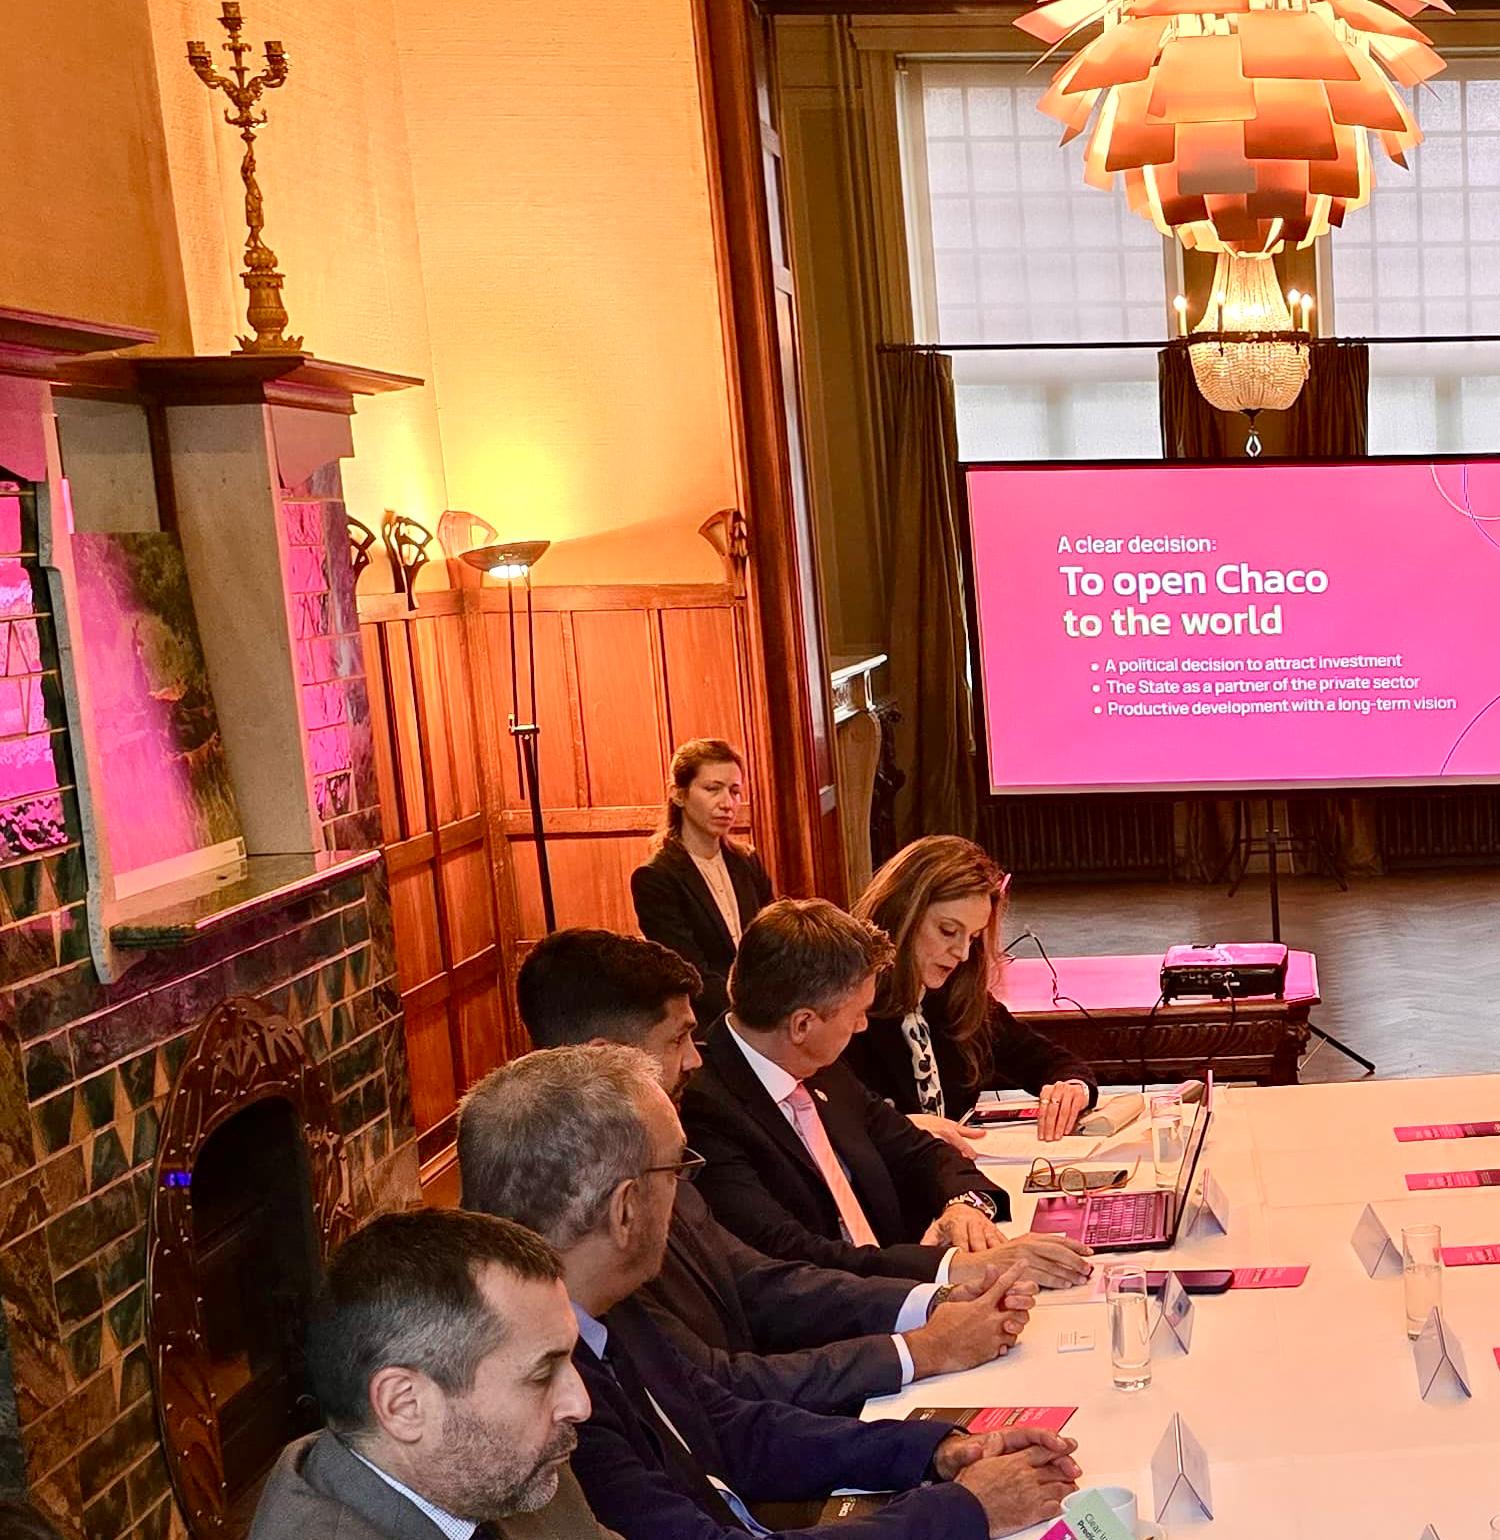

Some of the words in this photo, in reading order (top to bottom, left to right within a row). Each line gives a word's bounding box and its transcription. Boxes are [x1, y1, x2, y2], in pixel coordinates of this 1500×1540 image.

[1058, 536, 1072, 553] A
[1075, 535, 1124, 553] clear
[1127, 534, 1217, 553] decision:
[1059, 566, 1105, 597] To
[1113, 570, 1207, 604] open
[1215, 562, 1329, 594] Chaco
[1063, 609, 1103, 638] to
[1111, 607, 1171, 636] the
[1181, 605, 1283, 636] world
[1105, 659, 1116, 673] A
[1118, 657, 1179, 675] political
[1181, 657, 1244, 672] decision
[1246, 658, 1263, 671] to
[1265, 657, 1316, 671] attract
[1319, 654, 1402, 669] investment
[1106, 680, 1135, 693] The
[1138, 679, 1180, 694] State
[1183, 682, 1201, 693] as
[1203, 682, 1213, 693] a
[1215, 680, 1270, 696] partner
[1272, 678, 1289, 691] of
[1291, 677, 1317, 690] the
[1319, 677, 1371, 693] private
[1373, 676, 1420, 689] sector
[1107, 701, 1189, 716] Productive
[1191, 700, 1289, 716] development
[1291, 698, 1324, 711] with
[1326, 701, 1337, 711] a
[1338, 697, 1411, 715] long-term
[1413, 697, 1457, 710] vision
